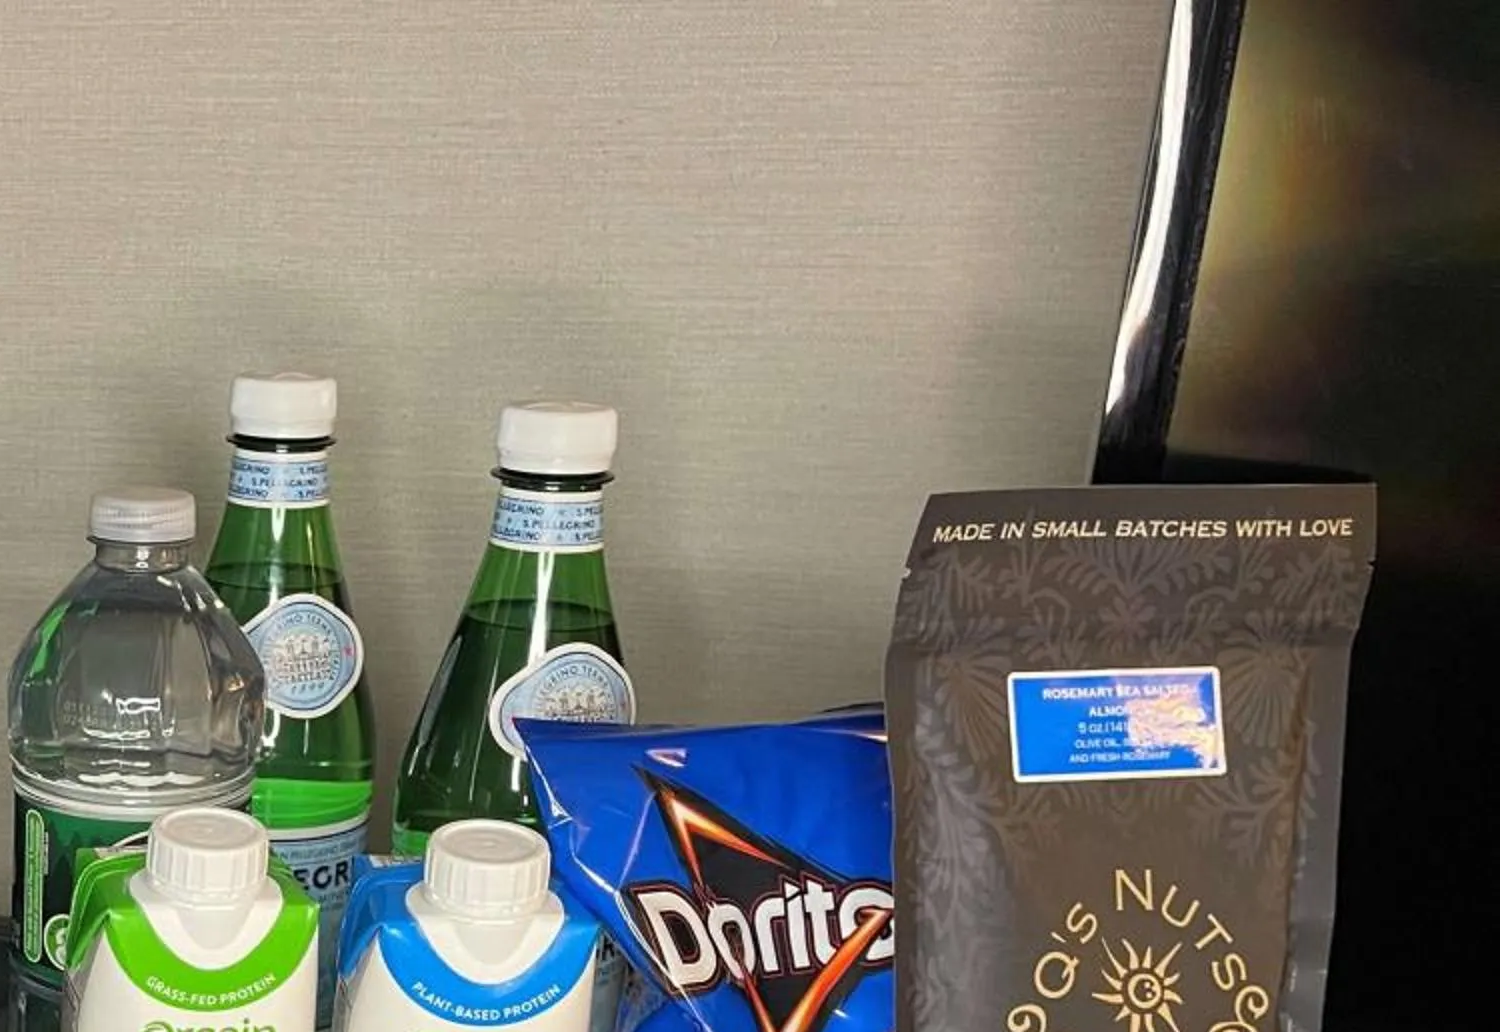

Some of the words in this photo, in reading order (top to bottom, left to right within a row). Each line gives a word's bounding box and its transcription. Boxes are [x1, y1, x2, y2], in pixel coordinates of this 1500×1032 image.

[932, 523, 995, 544] MADE
[999, 521, 1025, 541] IN
[1030, 520, 1107, 540] SMALL
[1114, 519, 1228, 539] BATCHES
[1235, 519, 1293, 538] WITH
[1299, 517, 1354, 538] LOVE
[1042, 685, 1114, 700] ROSEMARY
[1115, 683, 1141, 699] SEA
[1088, 705, 1129, 718] ALMO
[635, 879, 895, 986] Dorito
[1114, 868, 1248, 991] NUTS
[147, 974, 219, 1007] GRASS-FED
[219, 973, 277, 1006] PROTEIN
[411, 981, 501, 1021] PLANT-BASED
[503, 983, 562, 1019] PROTEIN
